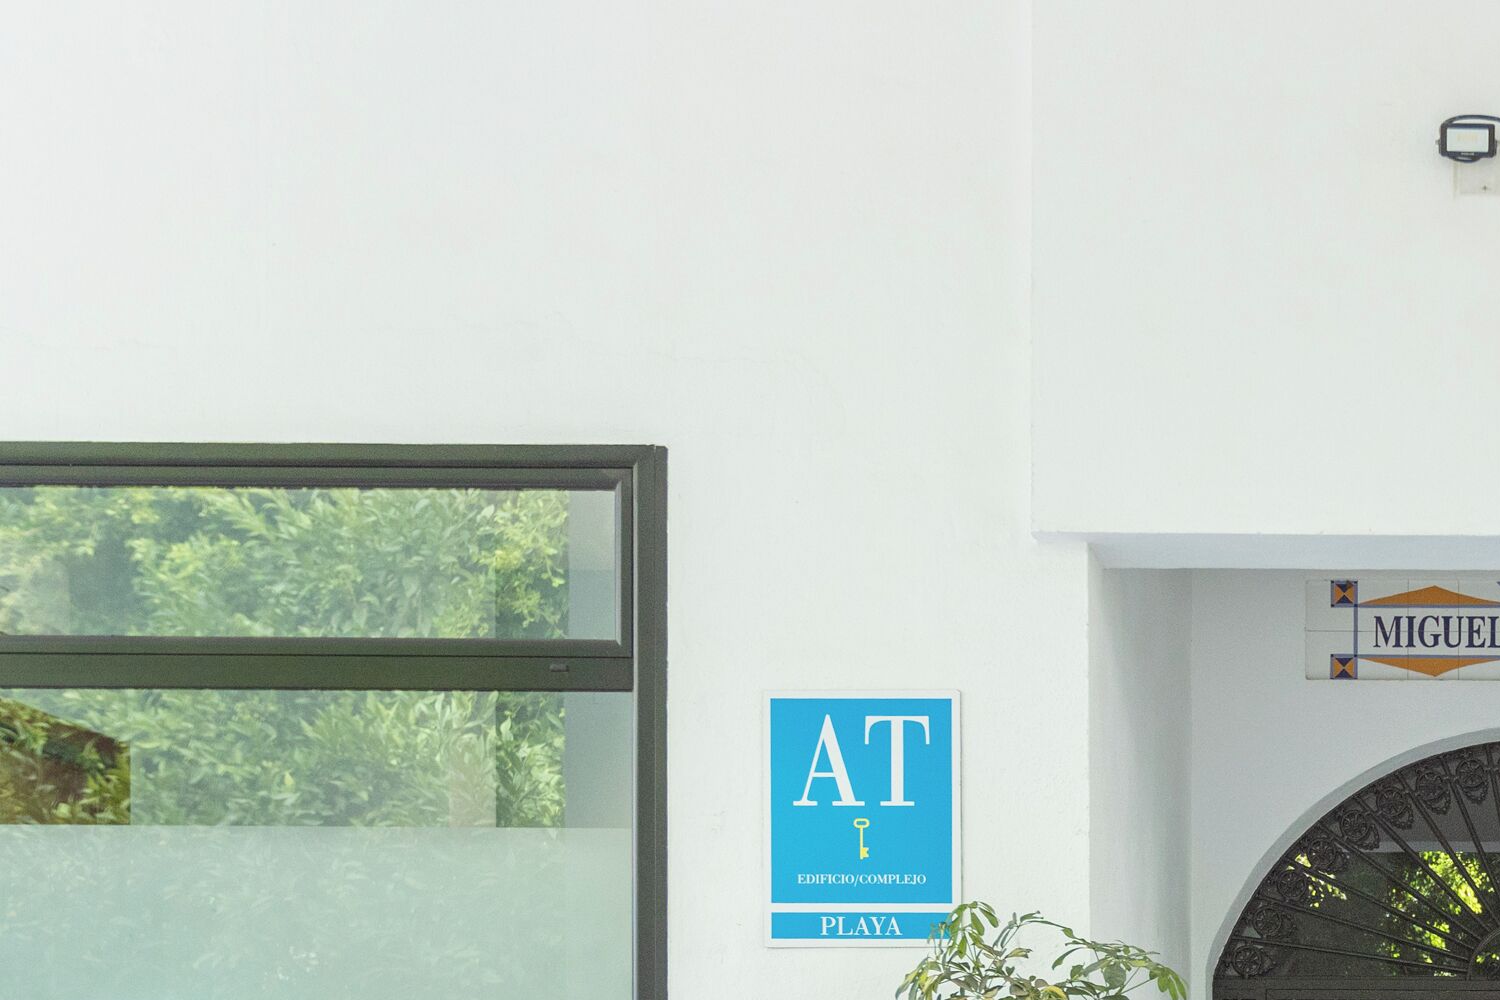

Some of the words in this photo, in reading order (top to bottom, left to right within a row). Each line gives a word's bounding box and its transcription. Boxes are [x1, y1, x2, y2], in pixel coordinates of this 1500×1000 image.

[793, 713, 930, 807] AT
[797, 873, 927, 887] EDIFICIO/COMPLEJO
[820, 916, 903, 936] PLAYA
